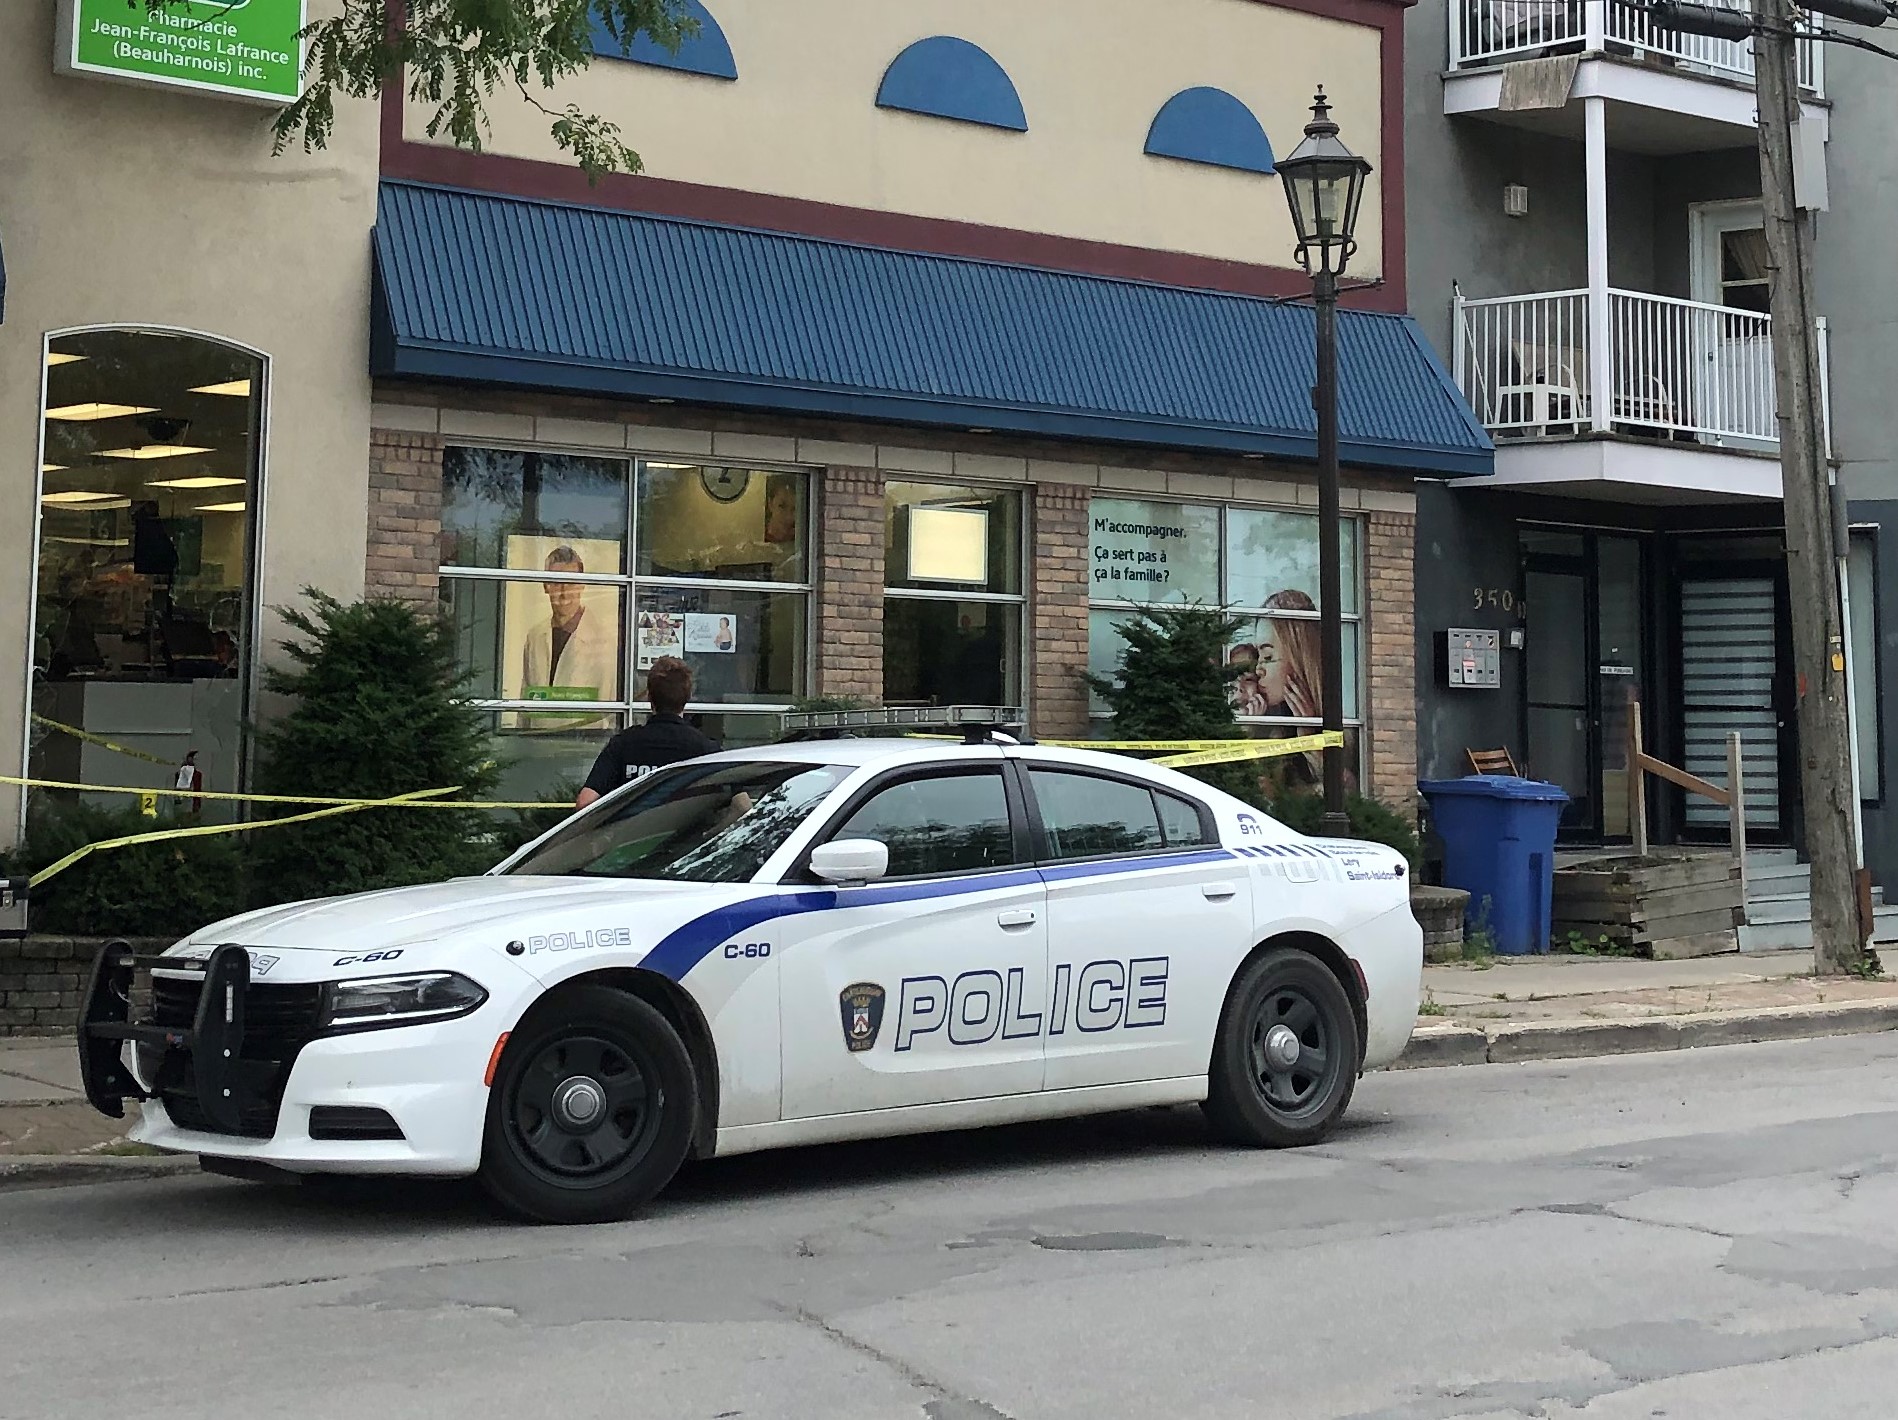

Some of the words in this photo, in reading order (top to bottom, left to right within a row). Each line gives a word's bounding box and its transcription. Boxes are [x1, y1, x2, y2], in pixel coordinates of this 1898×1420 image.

[91, 18, 211, 52] Jean-François
[216, 38, 289, 65] Lafrance
[113, 40, 232, 76] (Beauharnois)
[238, 61, 267, 80] inc.
[1094, 518, 1187, 539] M'accompagner.
[1094, 545, 1109, 562] Ça
[1112, 548, 1135, 561] sert
[1137, 551, 1157, 564] pas
[1159, 549, 1167, 563] à
[1094, 568, 1108, 582] ça
[1110, 565, 1121, 580] la
[144, 797, 153, 809] 2
[1240, 824, 1263, 835] 911
[528, 928, 632, 955] POLICE
[724, 942, 771, 959] C-60
[332, 949, 405, 967] C-60
[894, 956, 1169, 1053] POLICE
